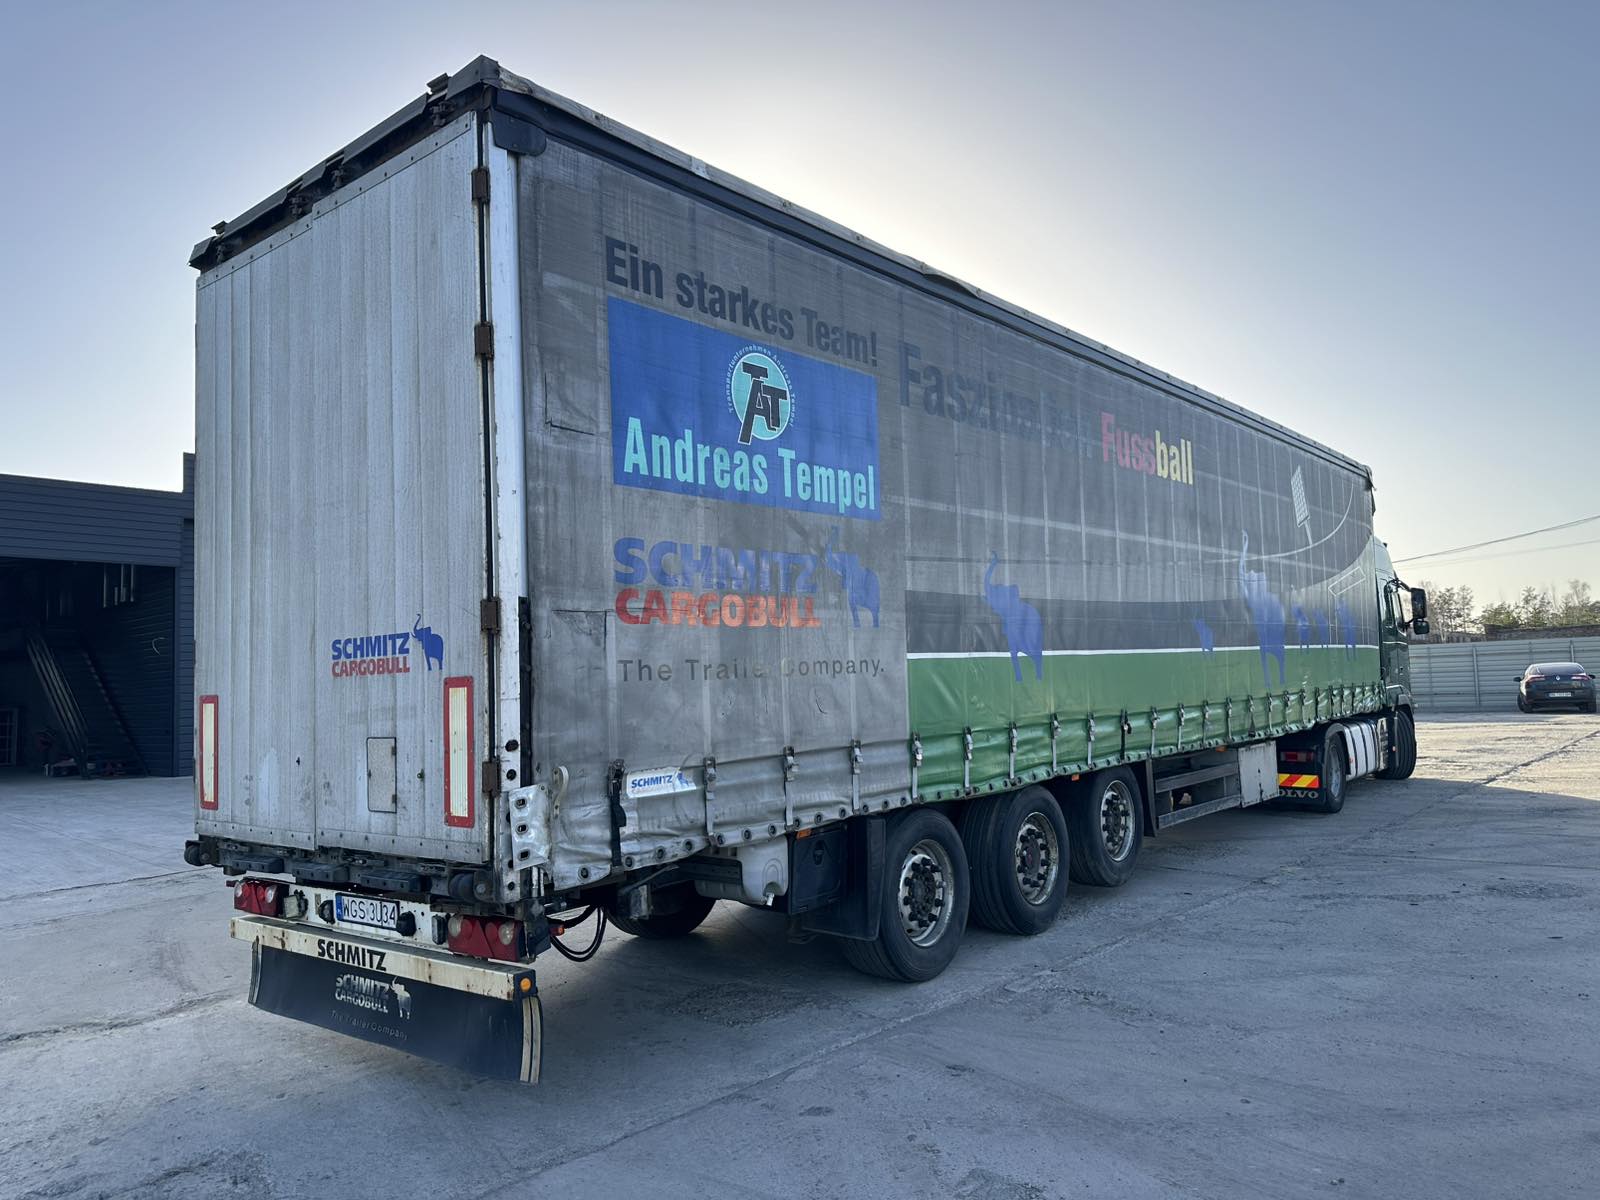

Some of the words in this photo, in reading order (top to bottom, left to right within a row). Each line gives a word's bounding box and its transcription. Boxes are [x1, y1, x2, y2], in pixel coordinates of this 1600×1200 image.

[605, 236, 663, 299] Ein
[676, 270, 794, 341] starkes
[801, 307, 877, 367] Team!
[1101, 411, 1193, 485] Fussball
[623, 416, 769, 495] Andreas
[777, 447, 876, 514] Tempel
[613, 537, 819, 593] SCHMITZ
[615, 588, 822, 629] CARGOBULL
[331, 632, 410, 660] SCHMITZ
[331, 656, 410, 678] CARGOBULL
[618, 659, 673, 682] The
[684, 658, 771, 681] Traile
[631, 774, 673, 789] SCHMITZ
[342, 898, 366, 920] WGS
[369, 901, 396, 925] 3U34
[317, 938, 387, 971] SCHMITZ
[335, 973, 390, 1000] SCHMITZ
